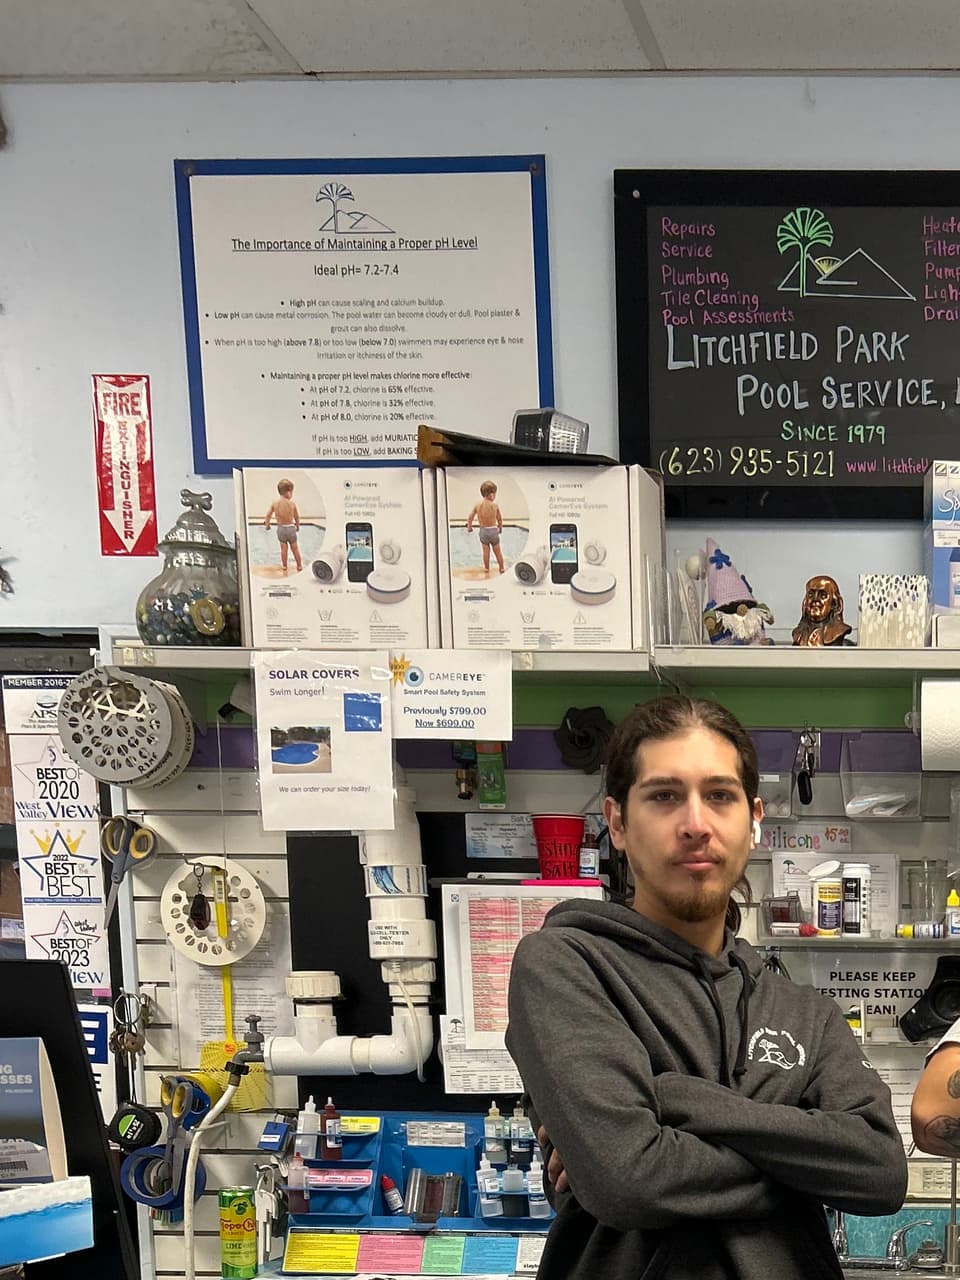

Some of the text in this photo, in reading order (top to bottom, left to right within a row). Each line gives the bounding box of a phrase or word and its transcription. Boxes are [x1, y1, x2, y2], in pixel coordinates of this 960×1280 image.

[662, 217, 715, 239] Repairs
[232, 239, 250, 248] The
[254, 239, 311, 249] Importance
[315, 238, 324, 249] of
[328, 238, 387, 249] Maintaining
[399, 238, 432, 248] Proper
[436, 237, 449, 248] pH
[452, 236, 477, 248] Level
[662, 241, 713, 258] Service
[314, 264, 398, 277] Ideal pH= 7.2-7.4
[661, 264, 729, 290] Plumbing
[661, 289, 759, 312] Tile Cleaning
[662, 306, 795, 326] Pool Assessments
[667, 325, 910, 370] LITCHFIELD PARK
[737, 374, 809, 416] POOL
[822, 376, 946, 410] SERVICE,
[103, 392, 142, 416] FIRE
[781, 420, 886, 444] SINCE 1979
[658, 446, 835, 477] (623) 935-5121
[117, 421, 135, 541] EXTINGUISHER
[269, 669, 359, 680] SOLAR COVERS
[429, 672, 482, 682] CAMEREYE
[8, 679, 42, 687] MEMBER
[270, 686, 325, 697] Swim Longer!
[440, 688, 460, 697] Safety
[462, 689, 486, 697] System
[403, 706, 486, 716] Previously $799.00
[415, 719, 474, 729] Now $699.00
[37, 768, 65, 780] BEST
[38, 781, 80, 800] 2020
[16, 801, 40, 810] West
[19, 807, 48, 820] Valley
[46, 801, 94, 819] VIEW
[760, 826, 821, 849] Silicone
[53, 854, 69, 862] 2022
[45, 863, 77, 875] BEST
[545, 861, 575, 877] Salt
[47, 876, 96, 897] BEST
[51, 938, 76, 949] BEST
[52, 950, 89, 967] 2023
[830, 971, 916, 981] PLEASE KEEP
